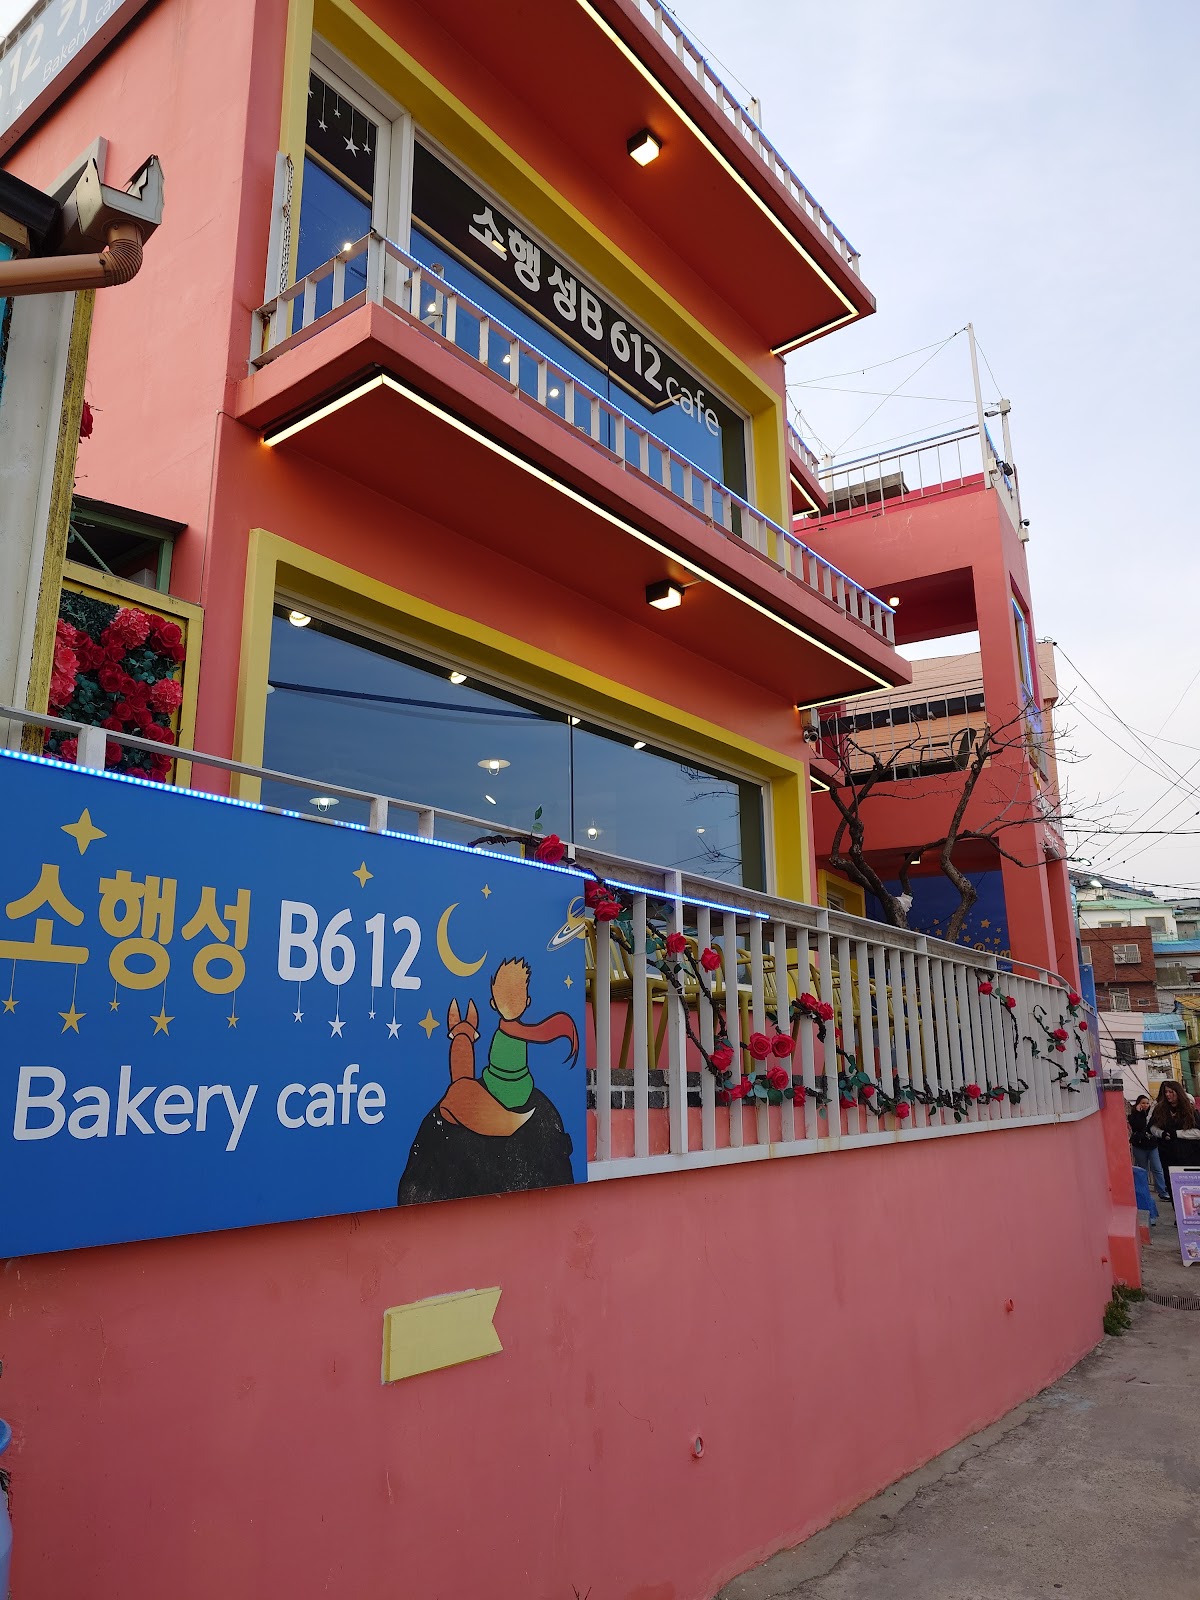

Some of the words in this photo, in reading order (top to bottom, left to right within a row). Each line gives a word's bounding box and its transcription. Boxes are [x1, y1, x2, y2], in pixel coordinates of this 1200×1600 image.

[0, 23, 45, 102] 12
[42, 21, 91, 83] Bakery
[94, 0, 118, 24] ca
[665, 376, 719, 437] cafe
[0, 863, 252, 995] 소행성
[277, 900, 422, 990] B612
[13, 1065, 258, 1152] Bakery
[276, 1063, 386, 1129] cafe
